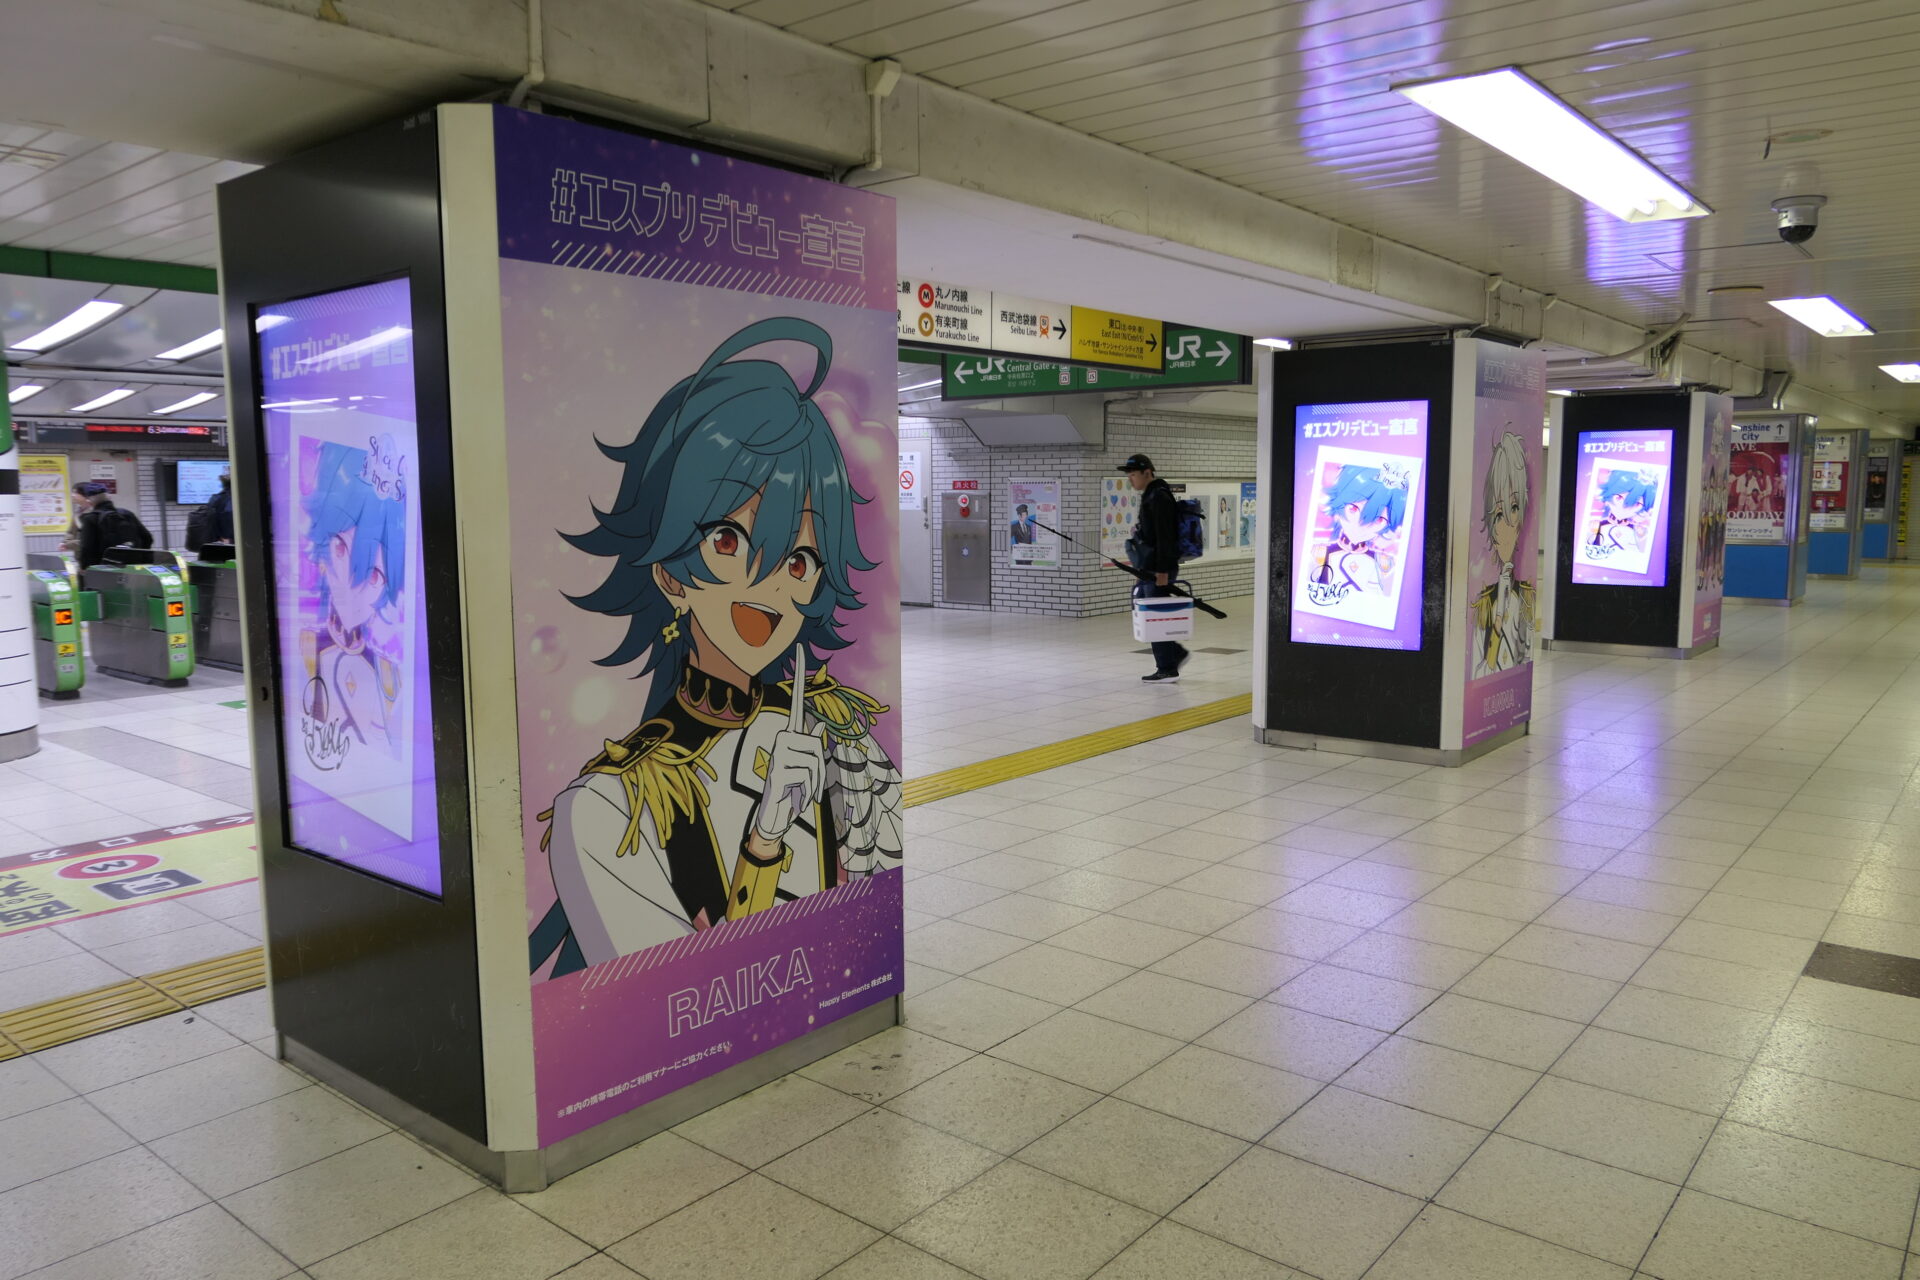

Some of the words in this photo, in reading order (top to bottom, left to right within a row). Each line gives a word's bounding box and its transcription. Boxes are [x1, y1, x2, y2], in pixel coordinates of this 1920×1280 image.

[550, 168, 866, 274] #エスプリデビュー宣言
[935, 285, 968, 303] 丸ノ内線
[934, 300, 969, 314] Marunouchi
[970, 306, 983, 316] Line
[935, 315, 968, 330] 有楽町線
[1000, 310, 1038, 326] 西武池袋線
[935, 329, 967, 341] Yurakucho
[967, 333, 980, 343] Line
[1010, 325, 1026, 336] Seibu
[1026, 327, 1038, 337] Line
[1166, 335, 1201, 360] JR
[1006, 363, 1032, 373] Central
[1033, 362, 1050, 371] Gate
[1732, 423, 1771, 432] nshine
[1731, 443, 1757, 451] AVE
[1726, 510, 1755, 520] OOD
[667, 946, 813, 1039] RAIKA
[818, 993, 841, 1010] Happy
[841, 982, 871, 1002] Elements
